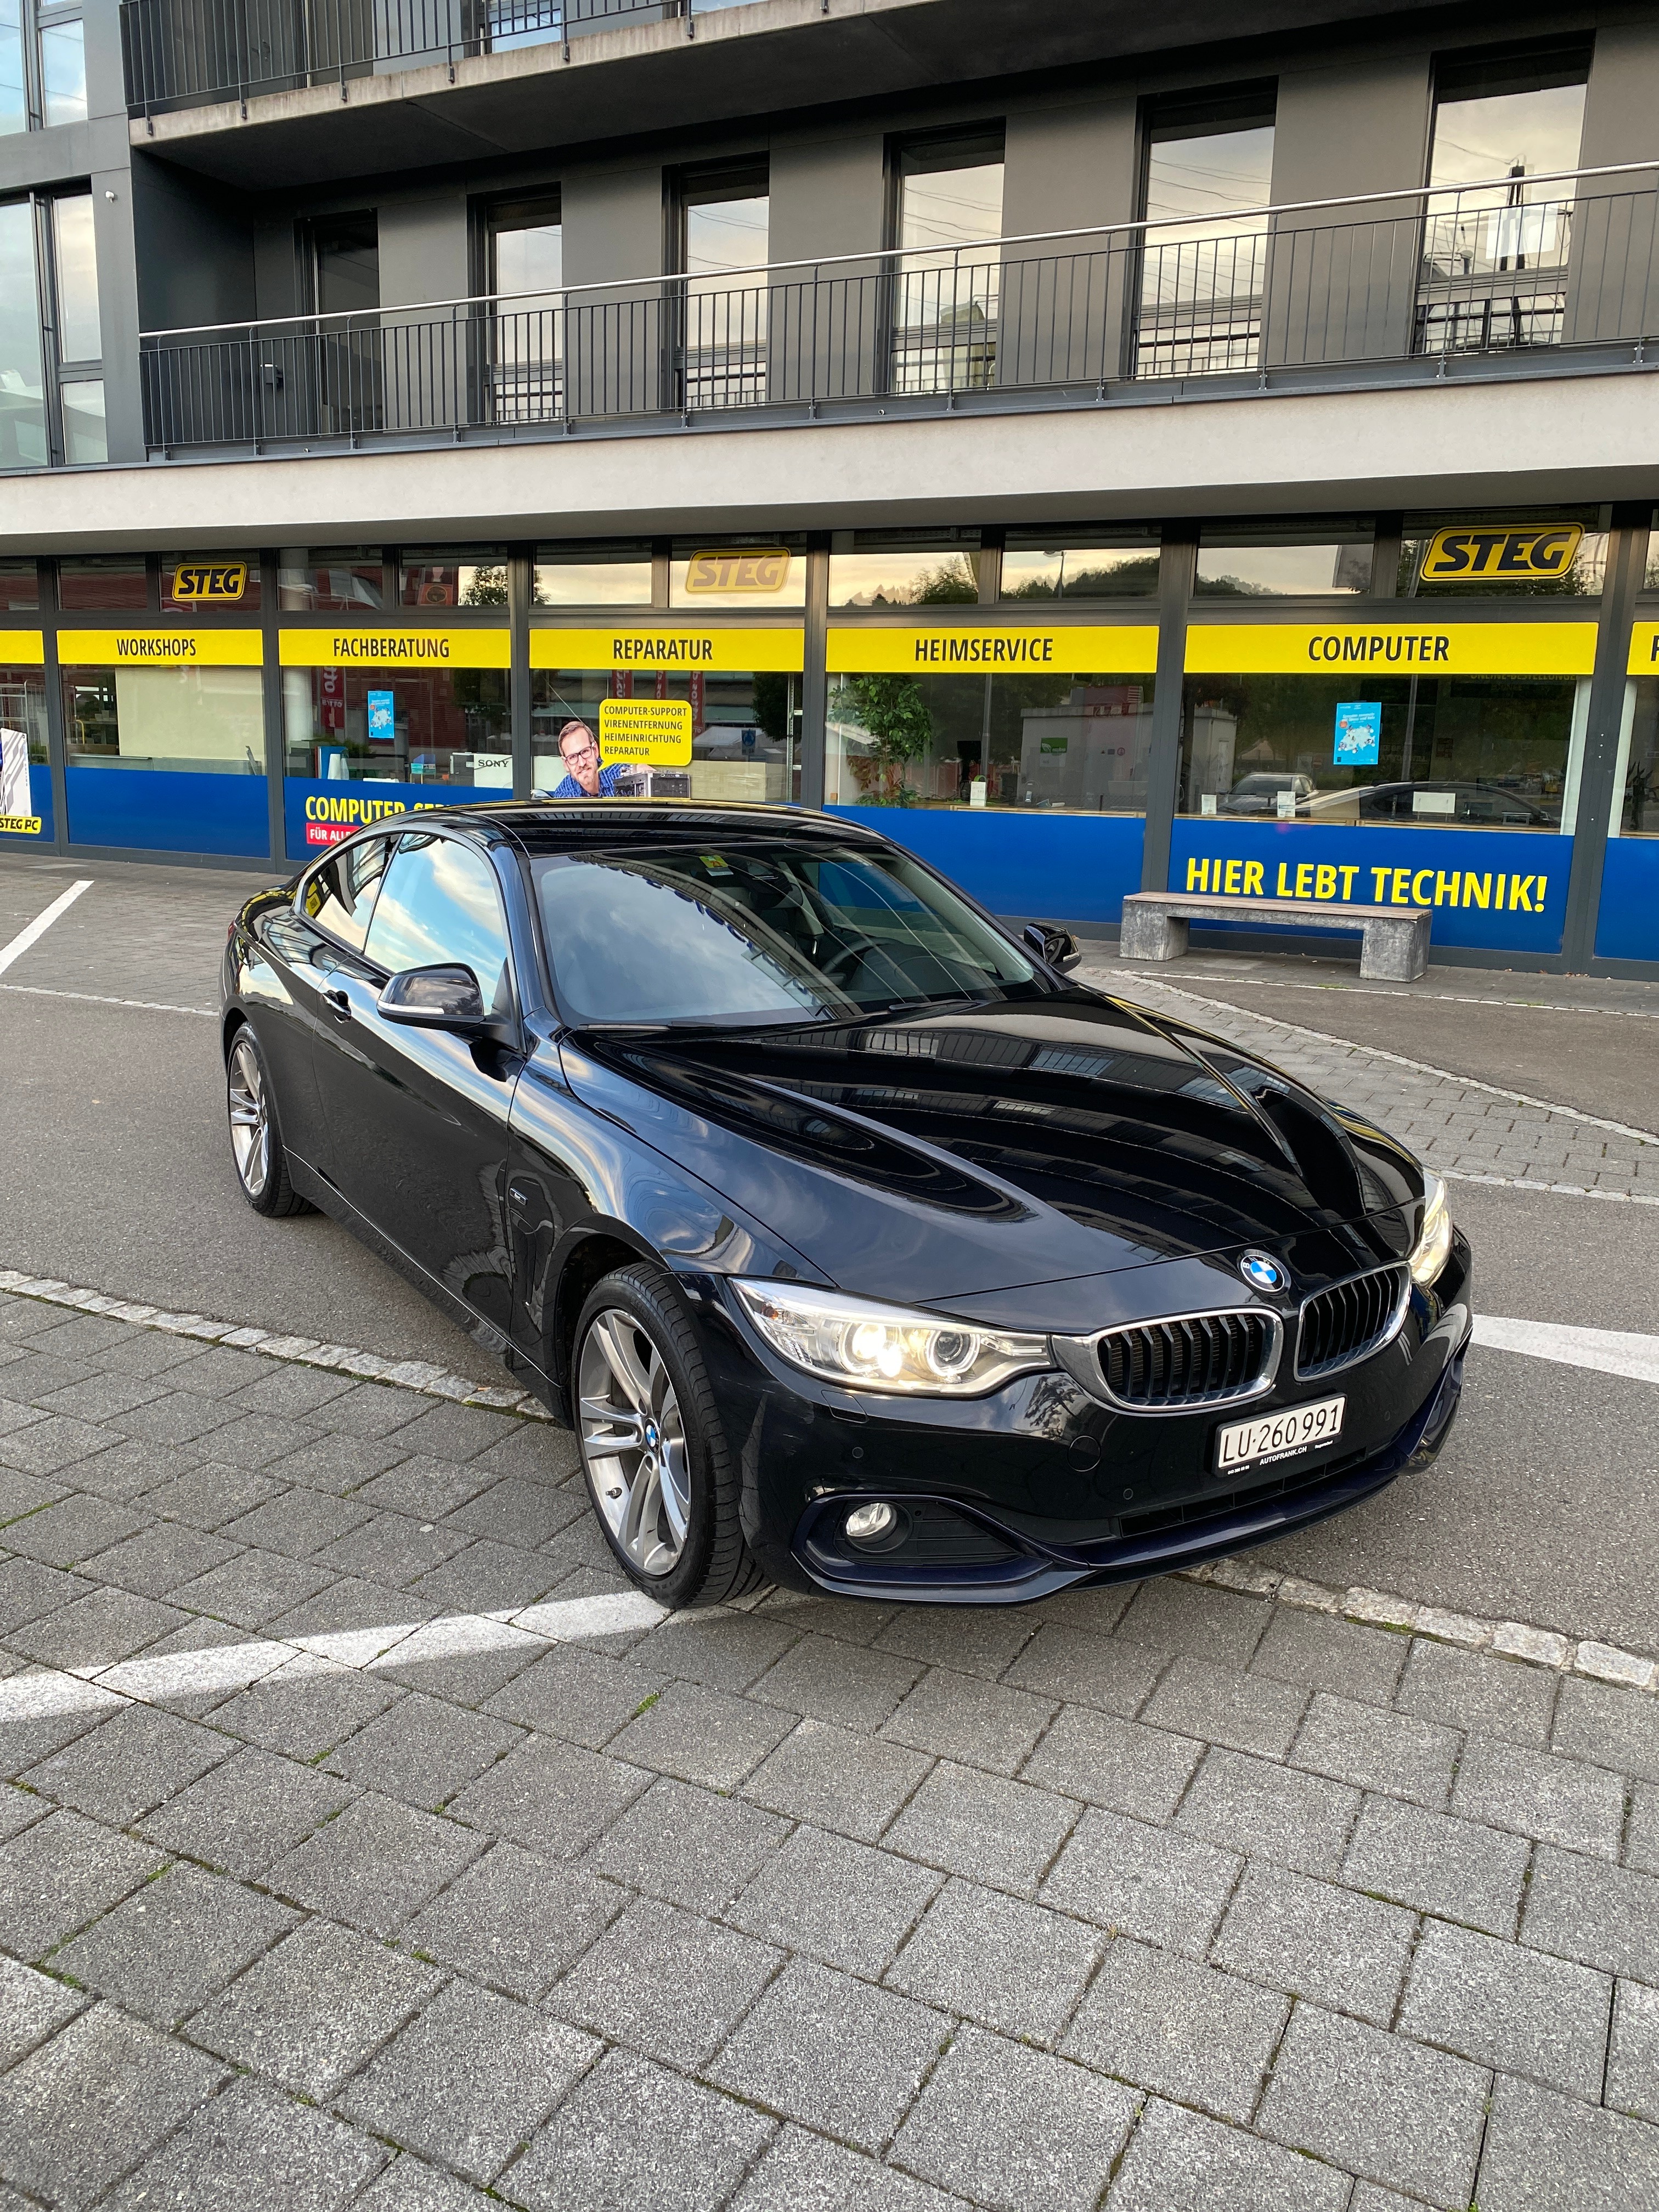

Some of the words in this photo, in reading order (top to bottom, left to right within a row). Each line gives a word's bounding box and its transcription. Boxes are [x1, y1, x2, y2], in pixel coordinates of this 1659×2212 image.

[1432, 532, 1573, 572] STEG
[692, 555, 783, 587] STEG
[178, 568, 241, 595] STEG
[116, 638, 196, 656] WORKSHOPS
[333, 638, 449, 658] FACHBERATUNG
[613, 639, 713, 660] REPARATUR
[915, 638, 1053, 662] HEIMSERVICE
[1308, 636, 1449, 661] COMPUTER
[604, 706, 687, 716] COMPUTER-SUPPORT
[604, 719, 682, 730] VIRENENTFERNUNG
[605, 733, 681, 743] HEIMEINRICHTUNG
[605, 746, 650, 756] REPARATUR
[478, 759, 509, 768] SONY
[25, 819, 38, 831] PC
[310, 827, 328, 840] FÜR
[1186, 857, 1264, 895] HIER
[1277, 862, 1360, 901] LEBT
[1370, 867, 1548, 912] TECHNIK!
[1260, 1446, 1307, 1466] AUTOFRANK.CH
